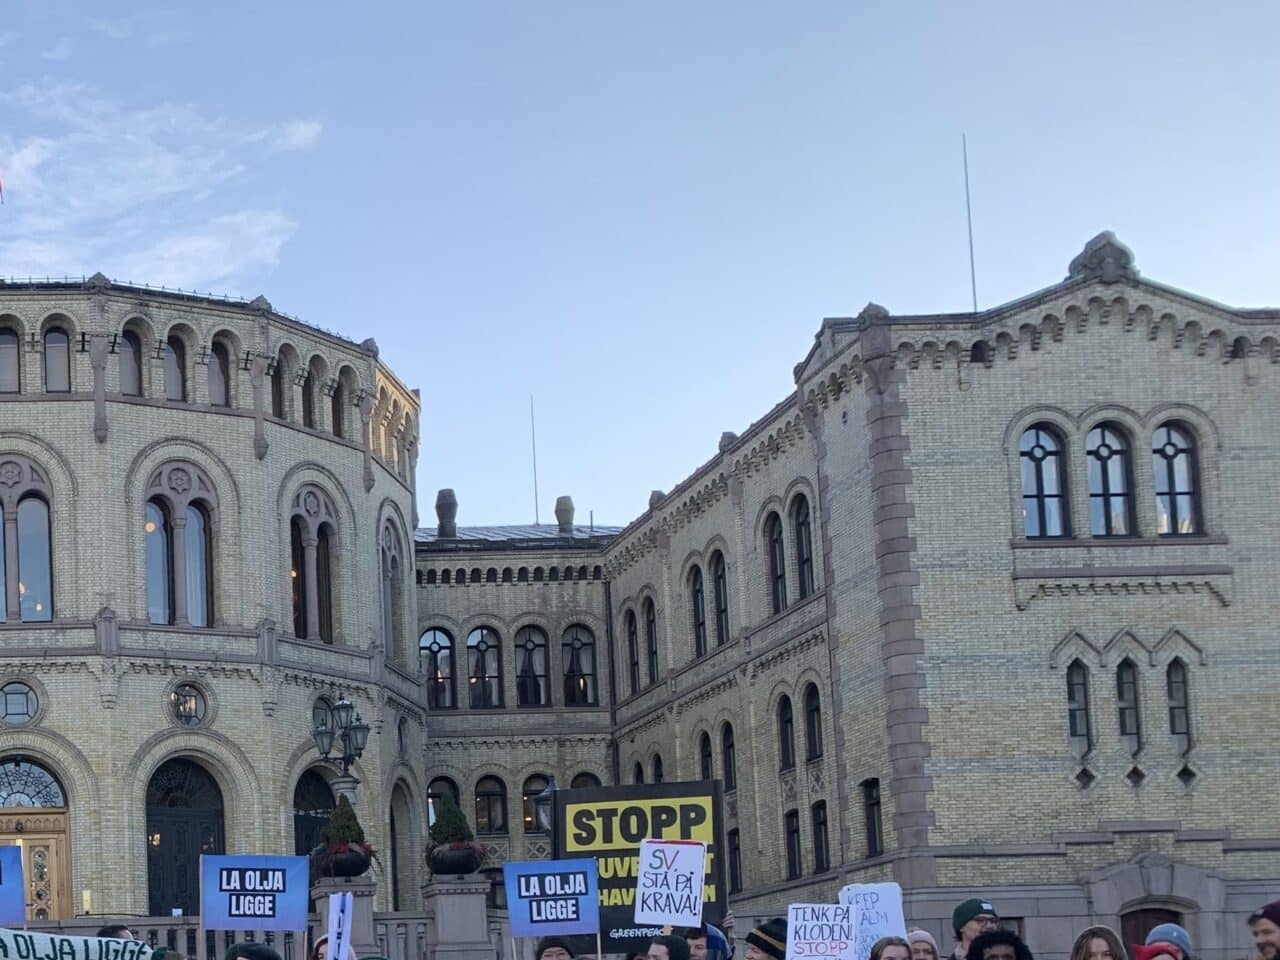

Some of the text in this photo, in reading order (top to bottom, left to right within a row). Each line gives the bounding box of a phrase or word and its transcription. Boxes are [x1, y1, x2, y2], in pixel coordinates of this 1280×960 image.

[572, 804, 707, 846] STOPP
[221, 870, 284, 890] LA OLJA
[520, 874, 586, 896] LA OLJA
[231, 895, 273, 915] LIGGE
[532, 900, 577, 921] LIGGE
[640, 892, 699, 916] KRAVA!
[791, 906, 830, 922] TENK
[860, 910, 889, 926] ALM
[609, 927, 666, 939] GREENPEAC
[793, 924, 853, 941] KLODEN!
[793, 942, 849, 955] STOPP
